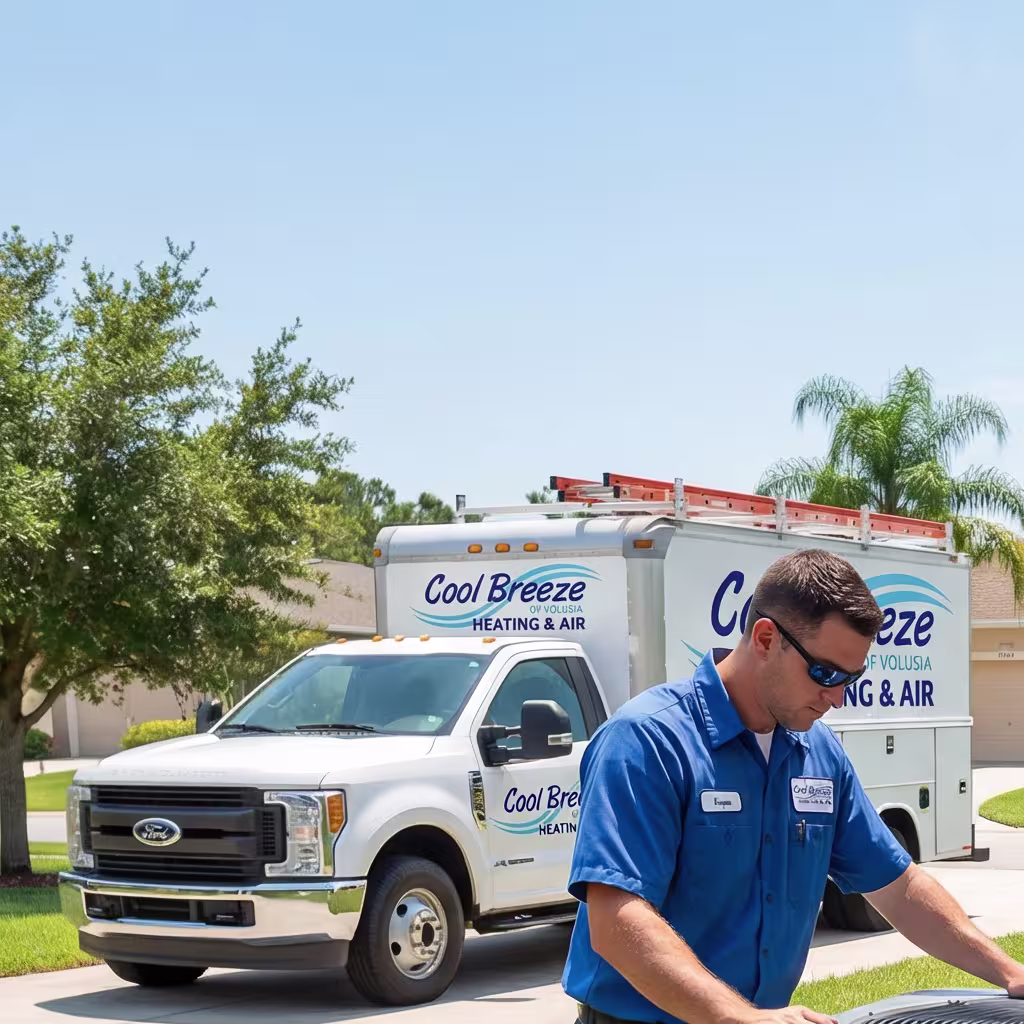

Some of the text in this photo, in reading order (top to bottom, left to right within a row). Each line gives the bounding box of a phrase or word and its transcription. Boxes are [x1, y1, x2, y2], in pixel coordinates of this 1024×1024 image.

[424, 572, 587, 604] Cool Breeze
[543, 604, 584, 614] VOLUSIA
[472, 616, 586, 631] HEATING & AIR
[876, 607, 935, 647] eze
[866, 654, 933, 671] F VOLUSIA
[879, 679, 896, 707] &
[899, 679, 935, 707] AIR
[503, 784, 582, 813] Cool Bre
[538, 822, 577, 836] HEATIN
